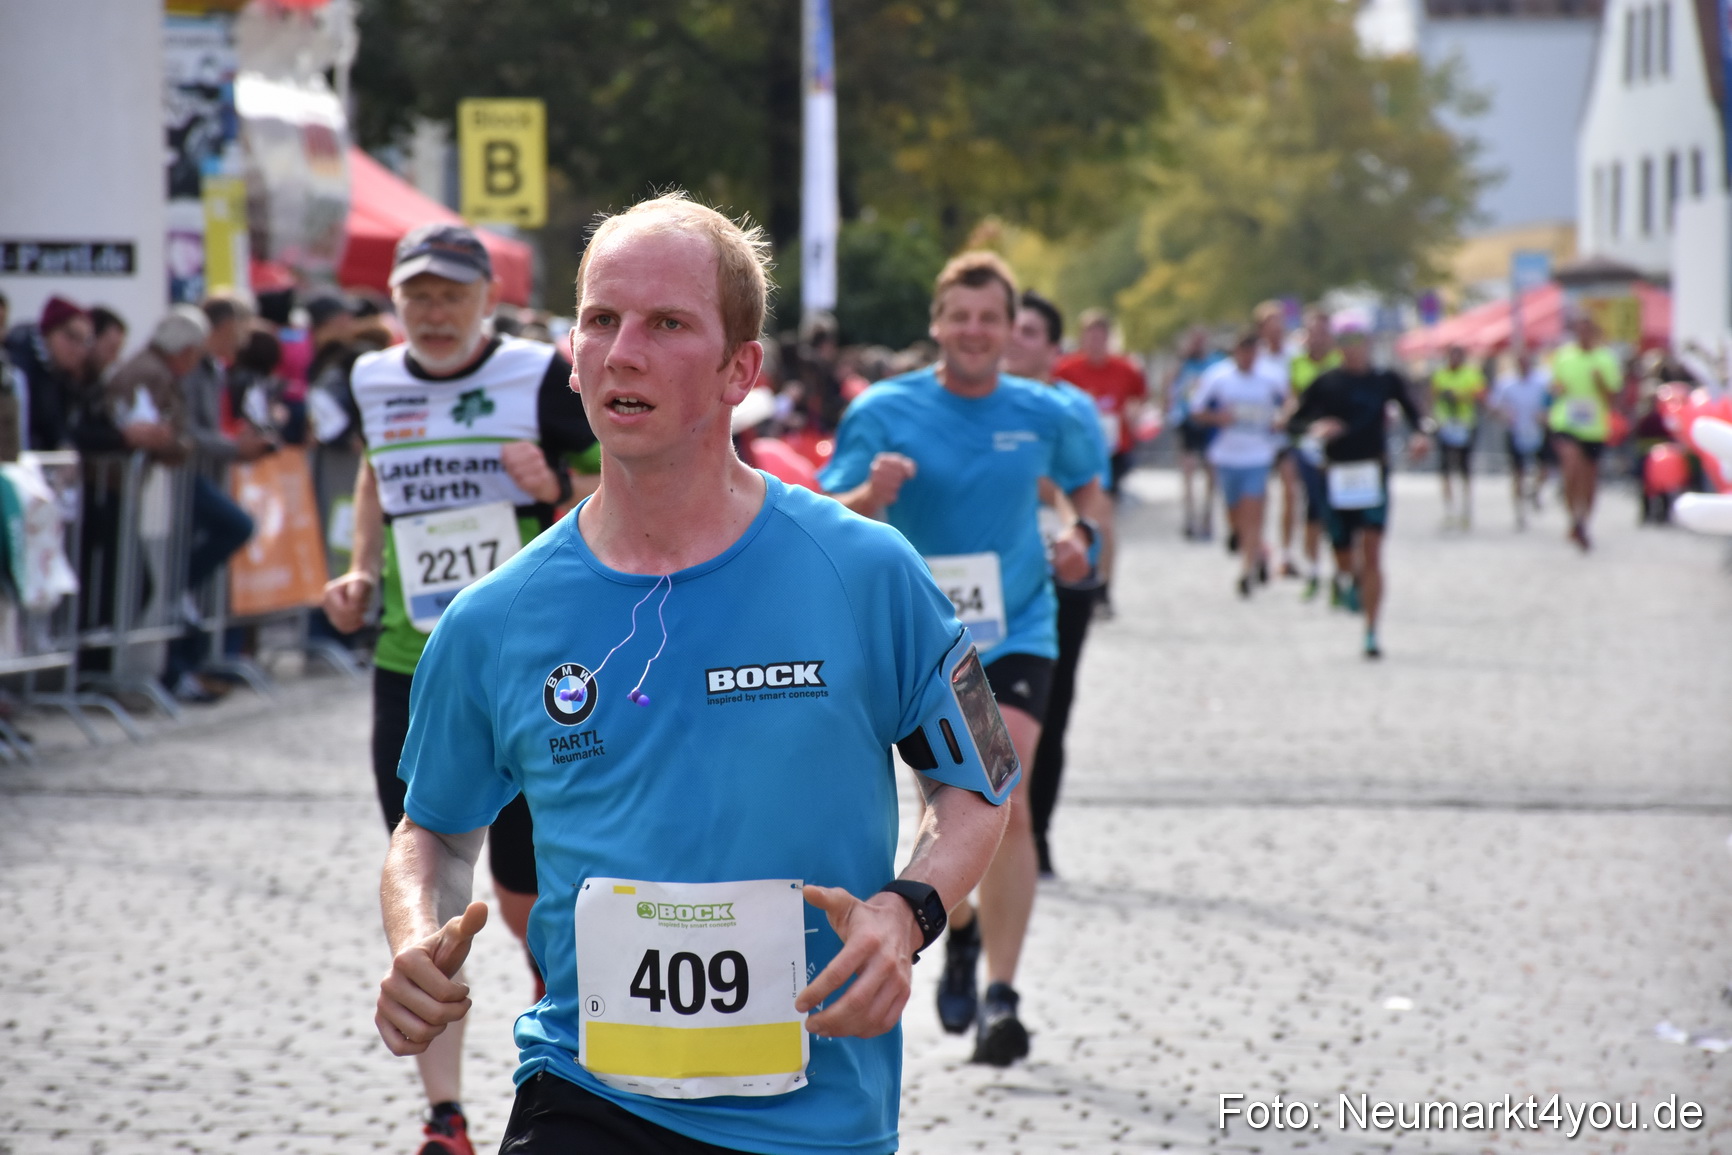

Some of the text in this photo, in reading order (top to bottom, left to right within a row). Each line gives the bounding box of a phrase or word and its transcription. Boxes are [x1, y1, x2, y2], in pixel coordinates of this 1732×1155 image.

[484, 140, 523, 197] B
[418, 539, 499, 585] 2217
[547, 665, 590, 689] BMW
[706, 662, 825, 694] BOCK
[707, 690, 829, 705] inspired by smart concepts
[549, 729, 603, 753] PARTL
[552, 745, 605, 765] Neumarkt
[658, 903, 735, 921] BOCK
[658, 921, 680, 929] inspired
[630, 949, 749, 1015] 409
[591, 1000, 599, 1012] D
